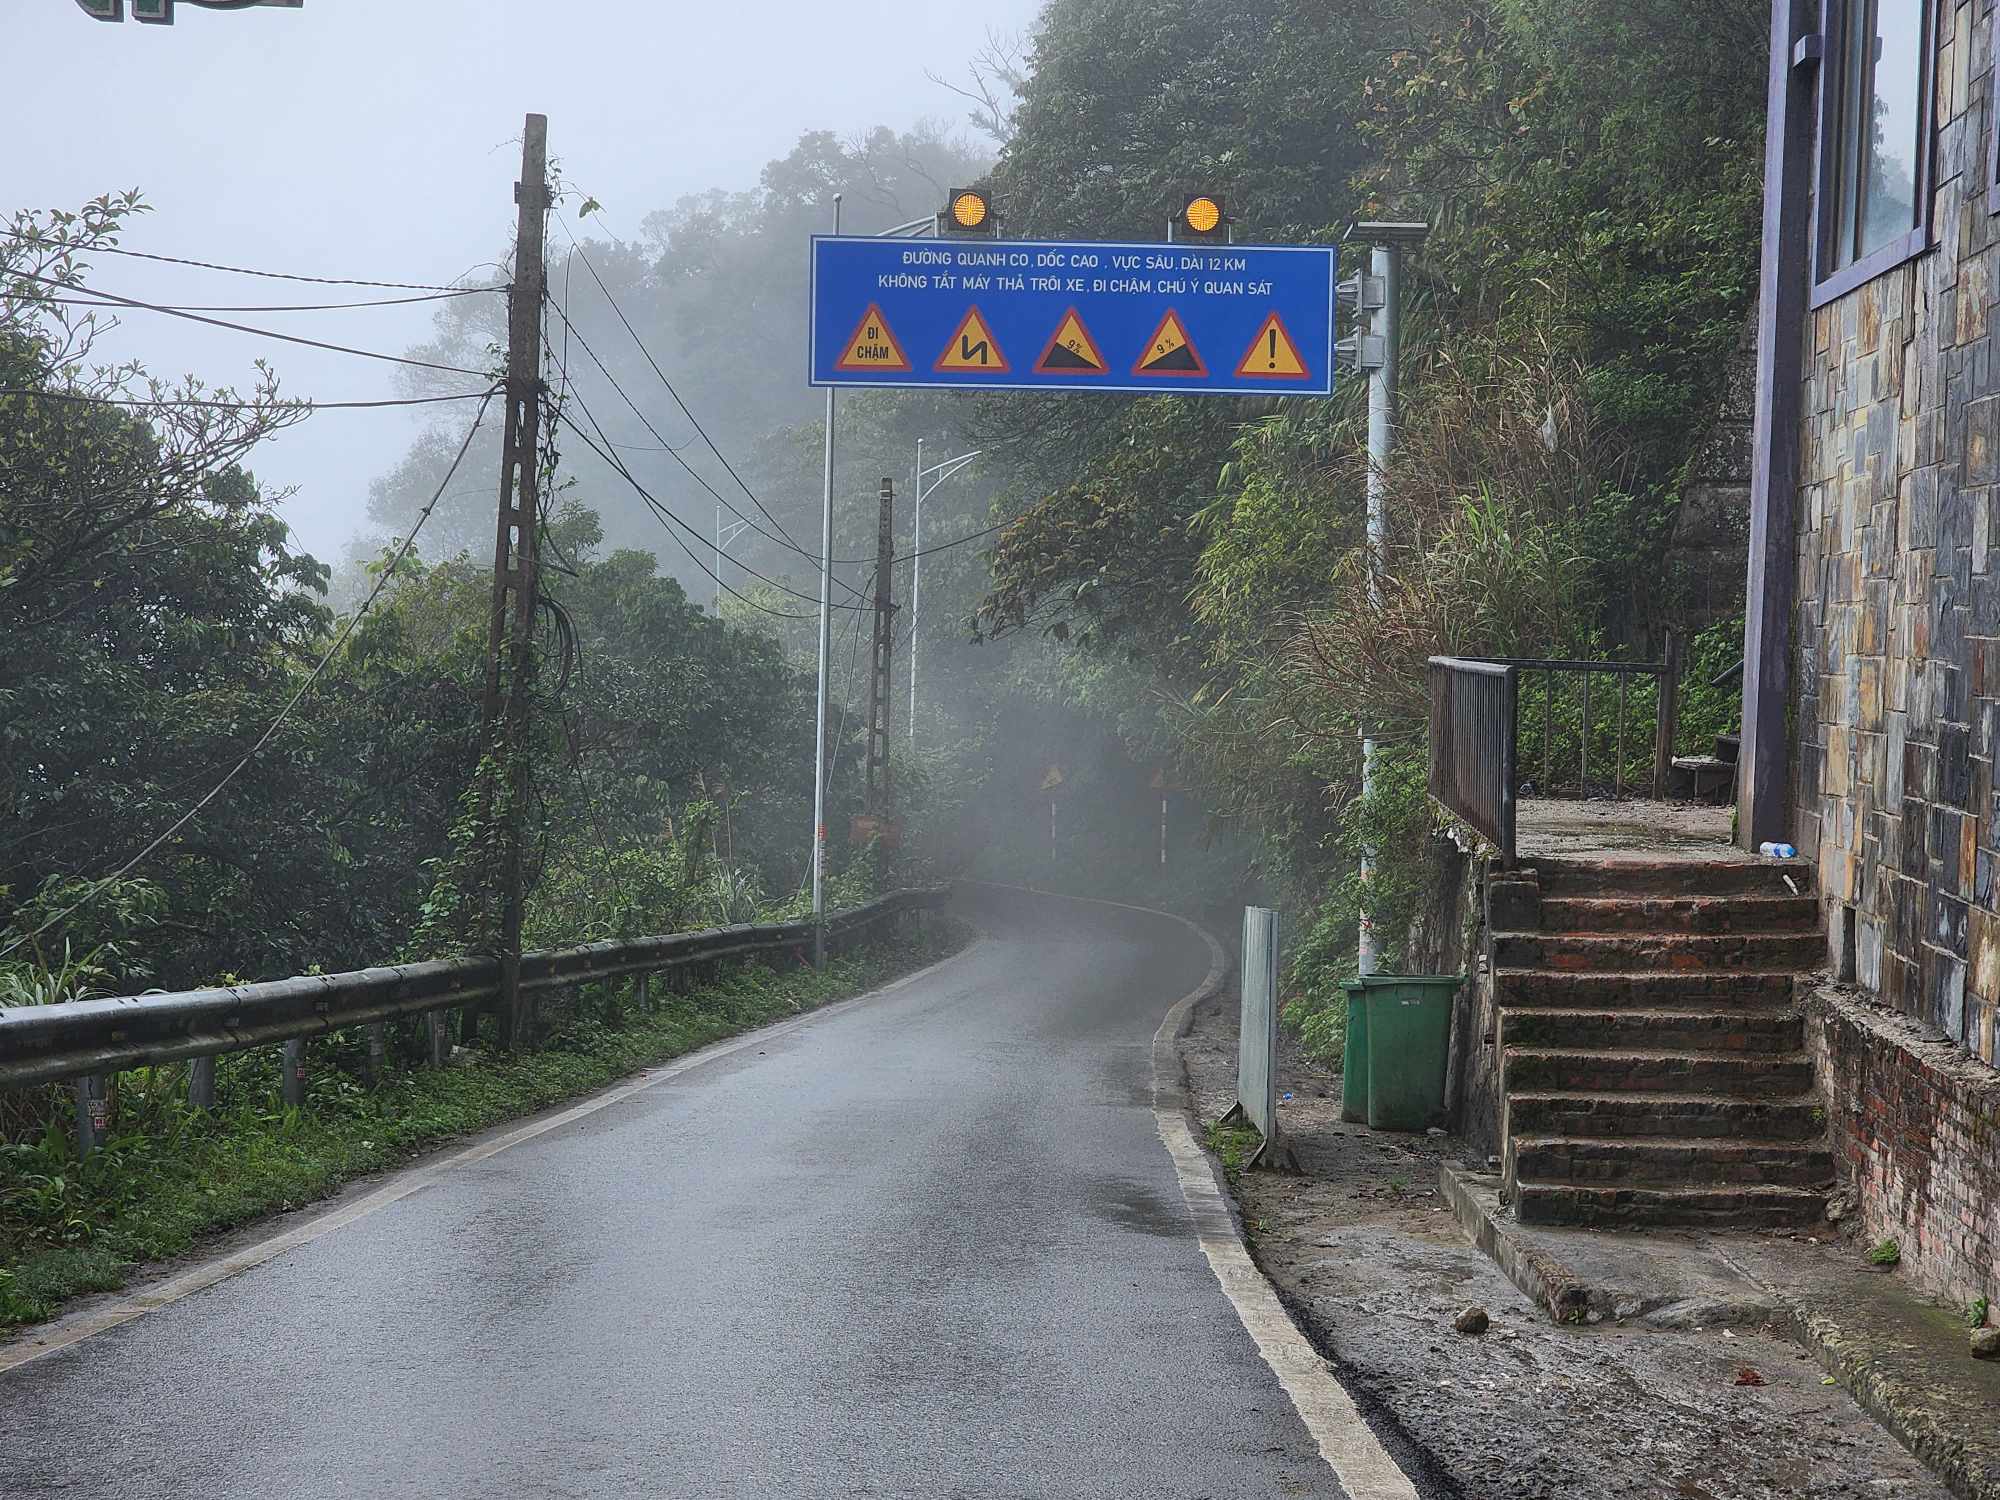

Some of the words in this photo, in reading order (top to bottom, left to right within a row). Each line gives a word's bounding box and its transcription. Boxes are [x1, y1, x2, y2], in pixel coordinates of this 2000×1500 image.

[903, 248, 952, 265] ĐƯỜNG
[957, 252, 1006, 267] QUANH
[1037, 248, 1066, 267] DỐC
[1112, 255, 1141, 272] VỰC
[1181, 253, 1204, 270] DÀI
[1209, 258, 1221, 271] 12
[1224, 258, 1247, 272] KM
[878, 273, 928, 288] KHÔNG
[932, 269, 957, 289] TẮT
[962, 273, 991, 290] MÁY
[996, 273, 1025, 291] THẢ
[1030, 275, 1061, 292] TRÔI
[1093, 279, 1107, 293] ĐI
[1157, 277, 1186, 294] CHÚ
[1190, 278, 1200, 294] Ý
[1204, 281, 1244, 295] QUAN
[1247, 280, 1273, 296] SÁT
[867, 326, 879, 340] ĐI
[857, 343, 889, 361] CHẬM
